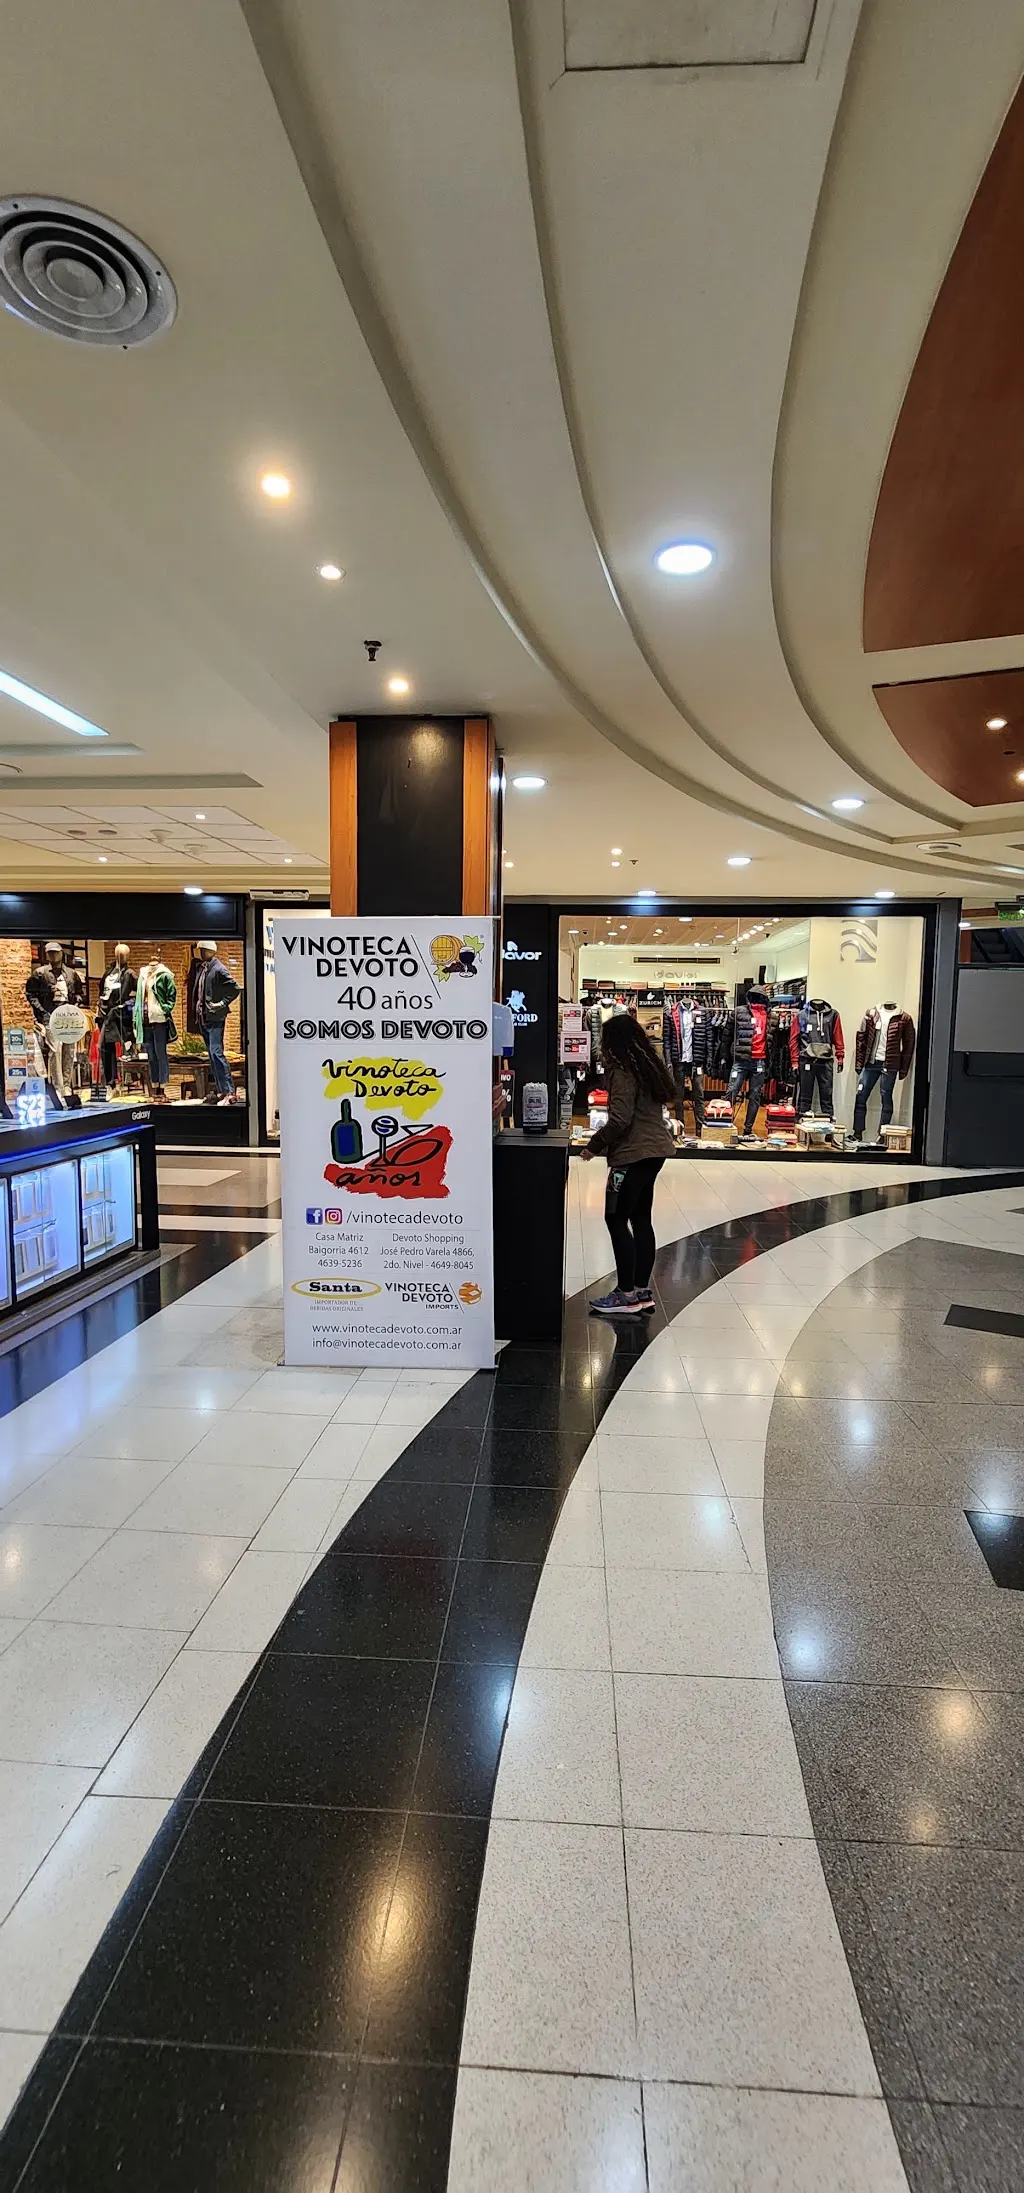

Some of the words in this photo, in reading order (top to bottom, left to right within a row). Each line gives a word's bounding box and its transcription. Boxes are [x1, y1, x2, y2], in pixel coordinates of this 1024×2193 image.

[282, 936, 412, 956] VINOTECA
[316, 958, 418, 978] DEVOTO
[337, 985, 376, 1010] 40
[381, 990, 433, 1010] años
[511, 1013, 538, 1022] FORD
[284, 1020, 375, 1040] SOMOS
[382, 1020, 488, 1040] DEVOTO
[322, 1058, 446, 1079] Vinoteca
[351, 1079, 437, 1098] Devoto
[131, 1110, 151, 1121] Galaxy
[336, 1167, 422, 1187] años
[347, 1210, 463, 1225] /vinotecadevoto
[315, 1232, 335, 1241] Casa
[337, 1232, 364, 1242] Matriz
[392, 1233, 423, 1243] Devoto
[425, 1233, 464, 1245] Shopping
[308, 1246, 346, 1256] Baigorria
[348, 1246, 369, 1255] 4612
[380, 1246, 398, 1256] José
[400, 1247, 424, 1256] Pedro
[426, 1247, 450, 1256] Varela
[452, 1247, 475, 1257] 4866,
[317, 1259, 363, 1268] 4639-5236
[383, 1260, 401, 1269] 2do.
[403, 1260, 424, 1269] Nivel
[431, 1261, 474, 1270] 4649-8045
[308, 1281, 363, 1293] Santa
[384, 1282, 450, 1292] VINOTECA
[402, 1293, 453, 1303] DEVOTO
[312, 1323, 463, 1335] www.vinotecadevoto.com.ar
[312, 1337, 462, 1351] info@vinotecadevoto.com.ar
